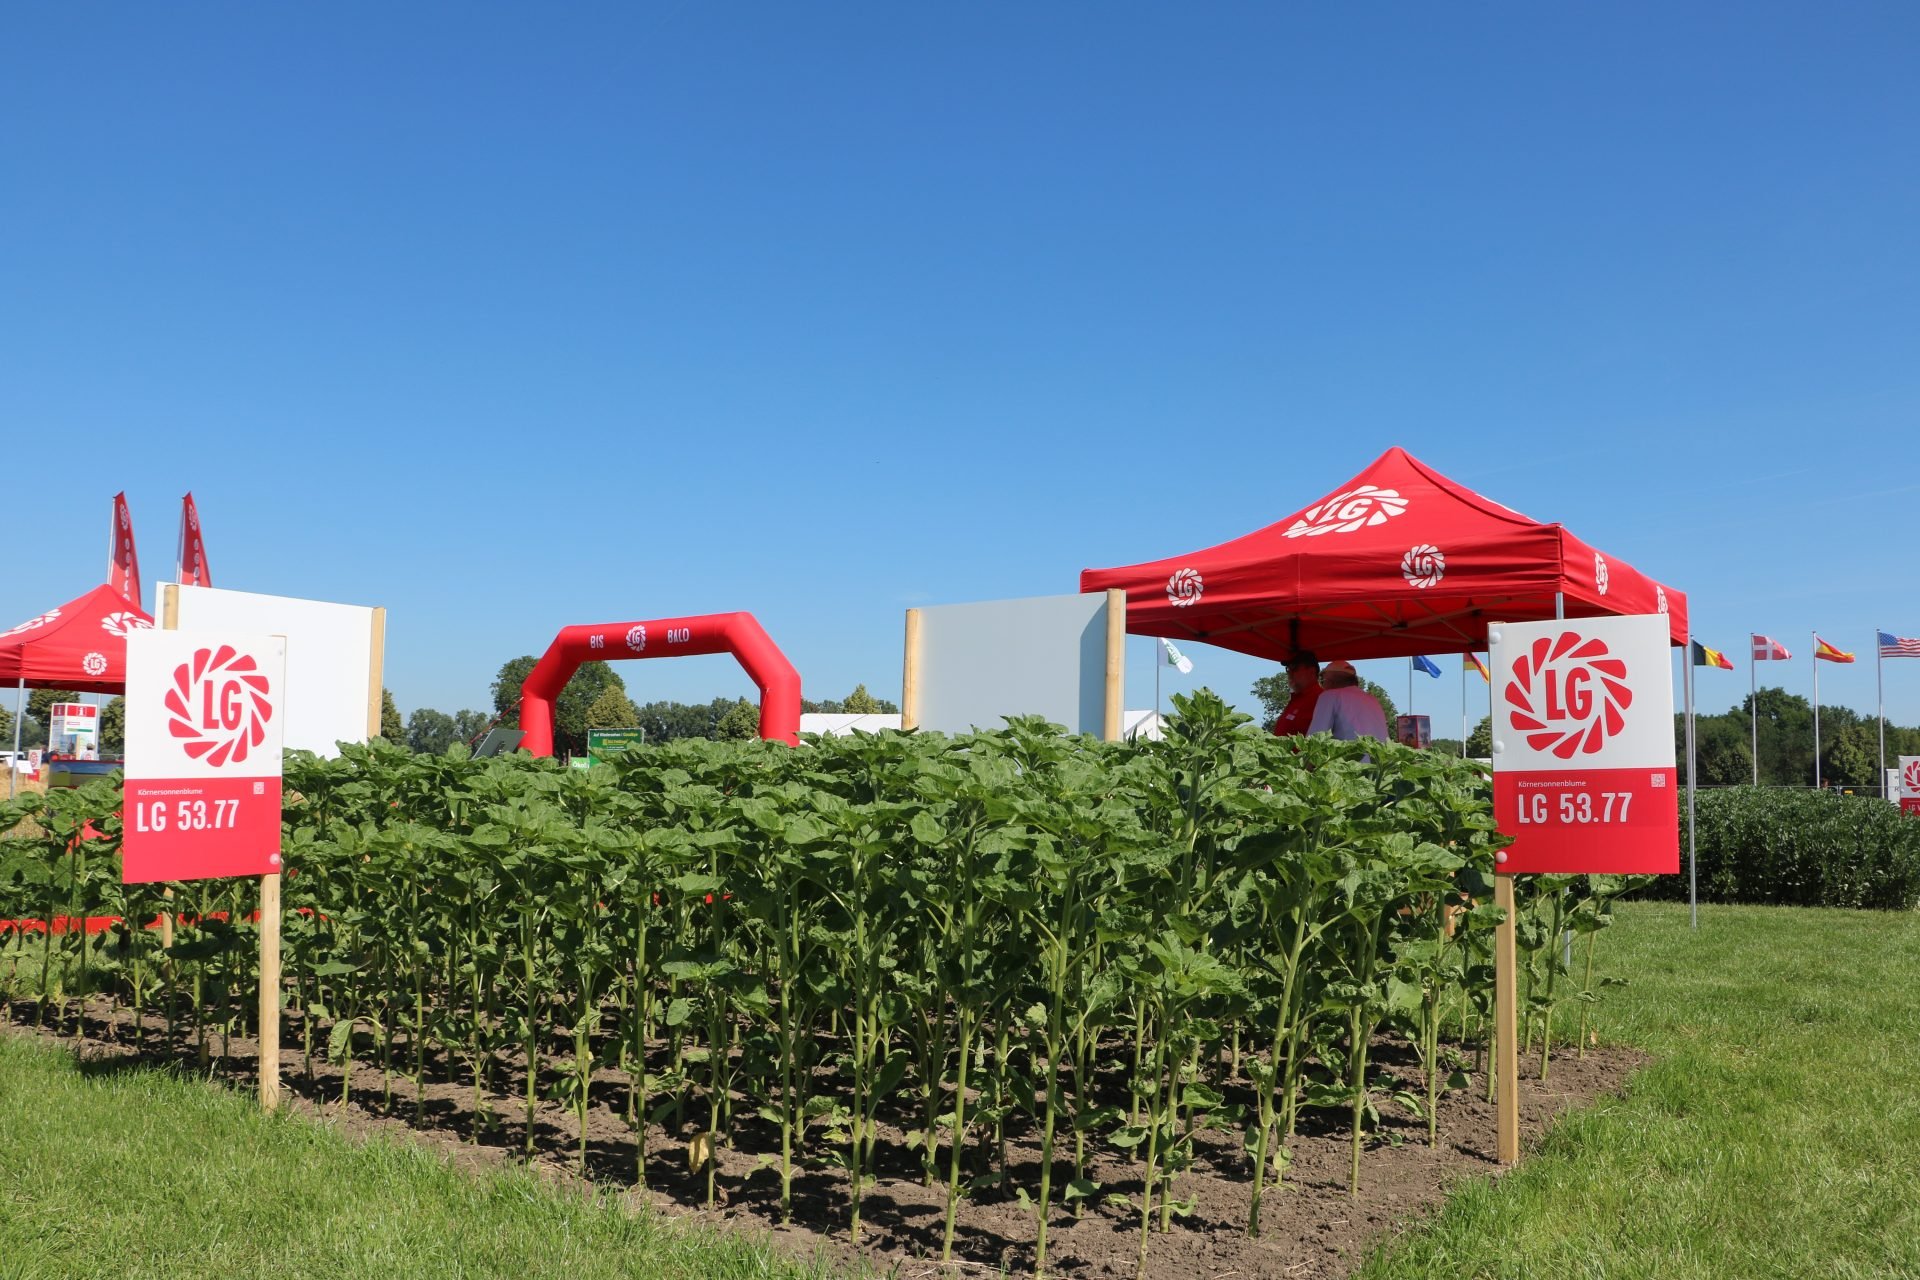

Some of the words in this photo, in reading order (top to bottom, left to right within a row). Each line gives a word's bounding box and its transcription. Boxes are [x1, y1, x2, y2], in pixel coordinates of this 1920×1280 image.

[1316, 498, 1373, 525] LG
[1415, 555, 1432, 576] LG
[1178, 578, 1193, 598] LG
[590, 634, 604, 649] BIS
[667, 627, 690, 644] BALD
[90, 658, 101, 669] LG
[1545, 666, 1593, 721] LG
[203, 679, 243, 731] LG
[137, 787, 204, 796] Körnersonnenblume
[1518, 780, 1587, 788] Körnersonnenblume
[136, 801, 167, 832] LG
[177, 799, 240, 831] 53.77
[1518, 793, 1548, 824] LG
[1560, 792, 1633, 824] 53.77
